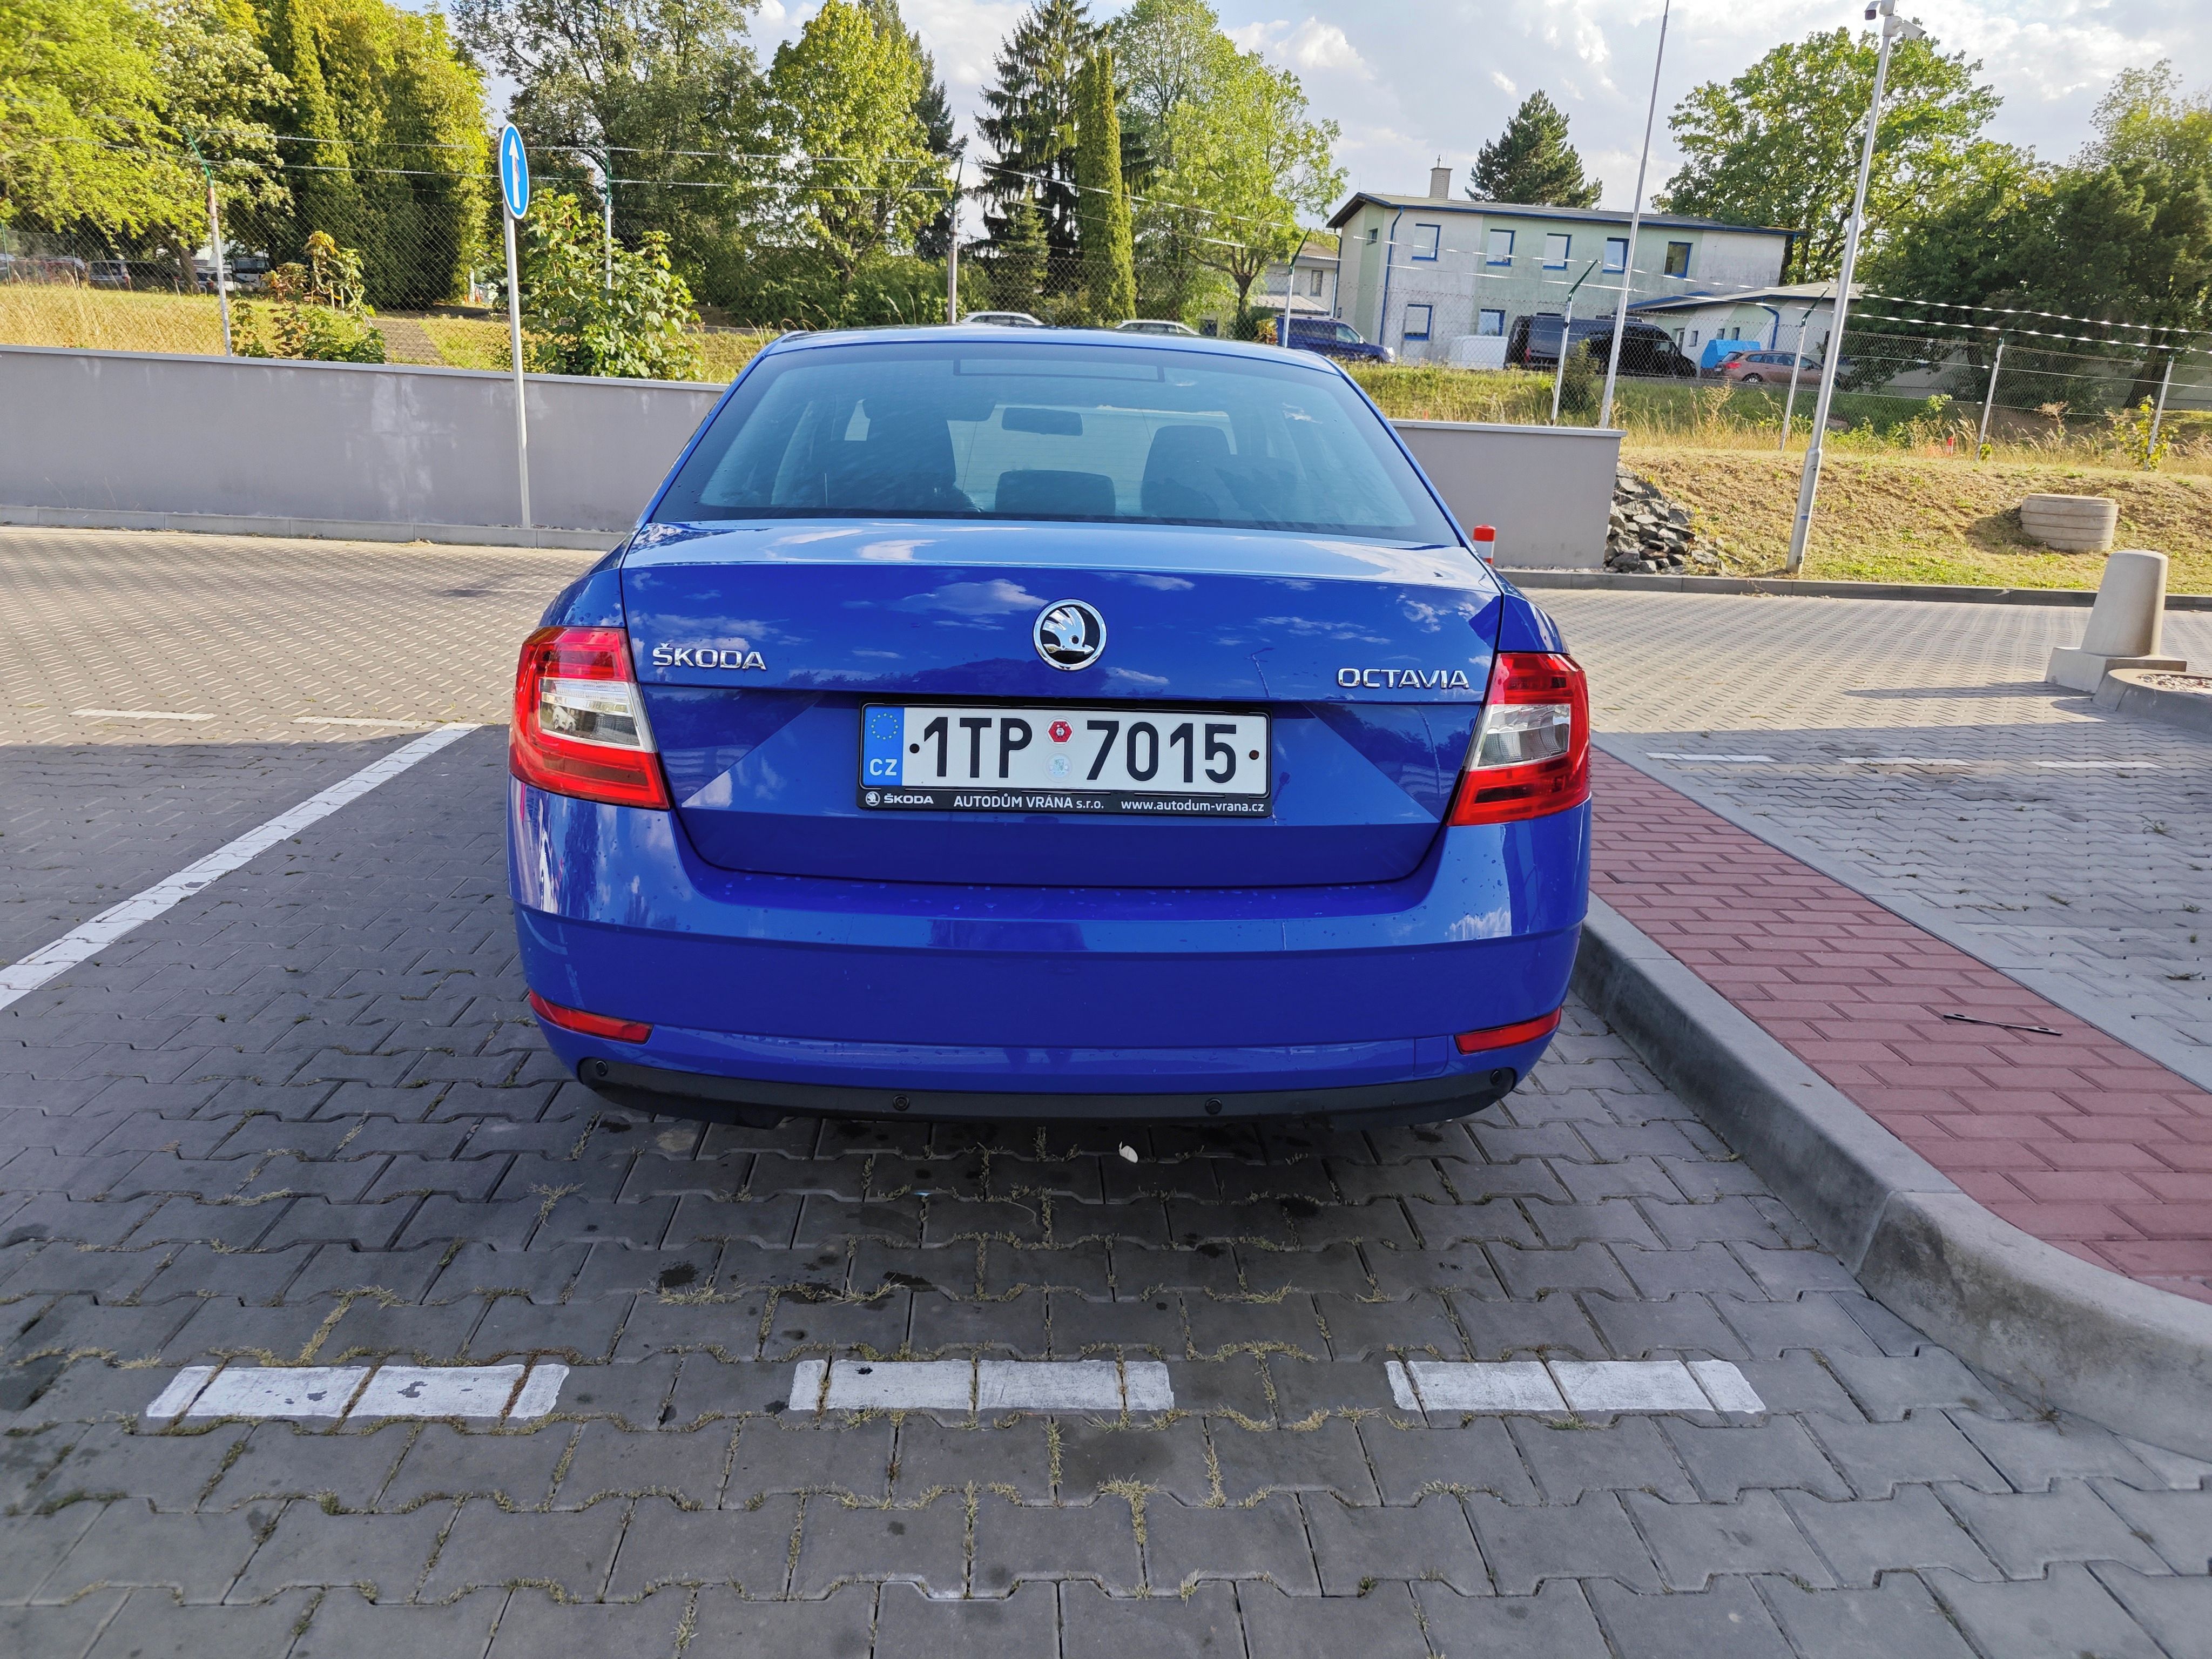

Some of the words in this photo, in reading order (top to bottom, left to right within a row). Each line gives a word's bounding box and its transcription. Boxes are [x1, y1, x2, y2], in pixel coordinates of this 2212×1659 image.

[652, 643, 767, 670] ŠKODA
[1338, 668, 1469, 689] OCTAVIA
[924, 716, 1033, 778] 1TP
[1087, 720, 1237, 784] 7015
[869, 758, 898, 776] CZ
[884, 793, 934, 804] ŠKODA
[954, 793, 1022, 808] AUTODŮM
[1026, 794, 1073, 808] VRÁNA
[1076, 799, 1104, 809] s.r.o.
[1121, 799, 1264, 812] www.autodum-vrana.cz
